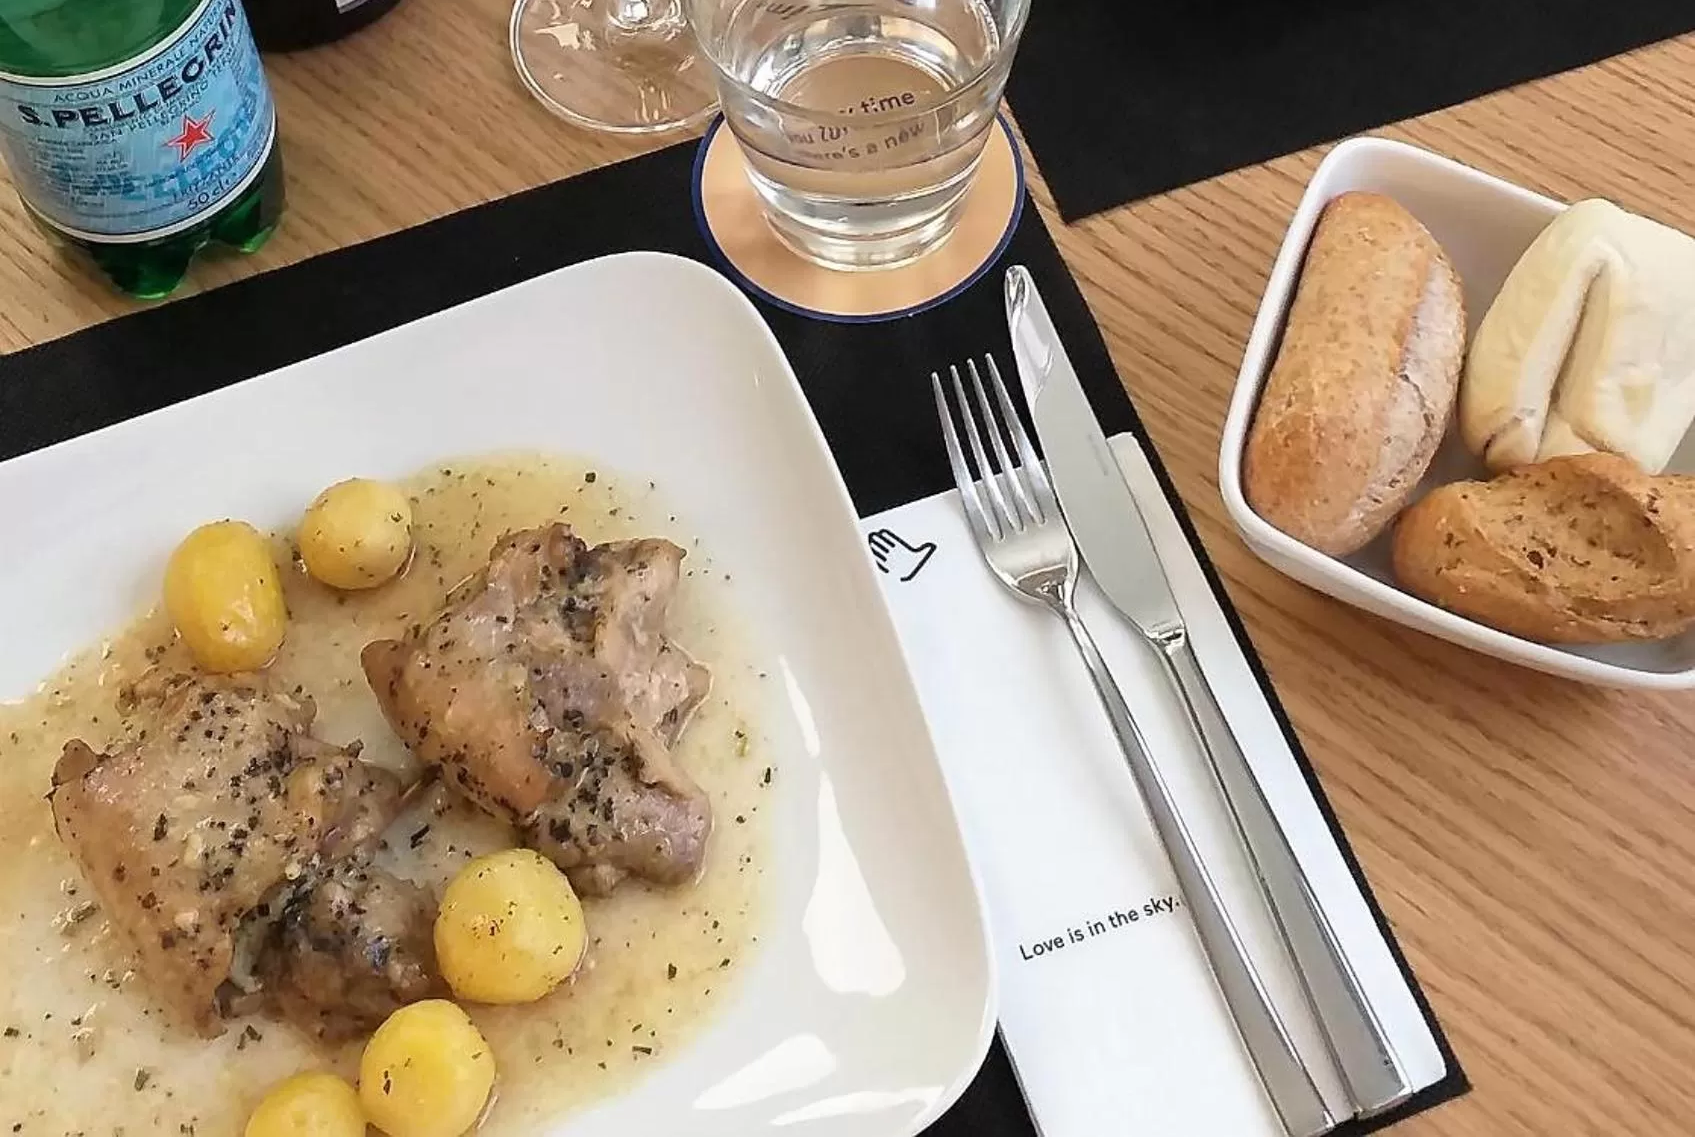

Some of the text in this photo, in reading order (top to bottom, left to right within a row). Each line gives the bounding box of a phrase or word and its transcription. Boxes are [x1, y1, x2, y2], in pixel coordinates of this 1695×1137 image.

[53, 87, 113, 104] ACQUA
[119, 47, 186, 92] MINERALE
[860, 92, 915, 113] time
[1019, 896, 1181, 961] Love is in the sky.
